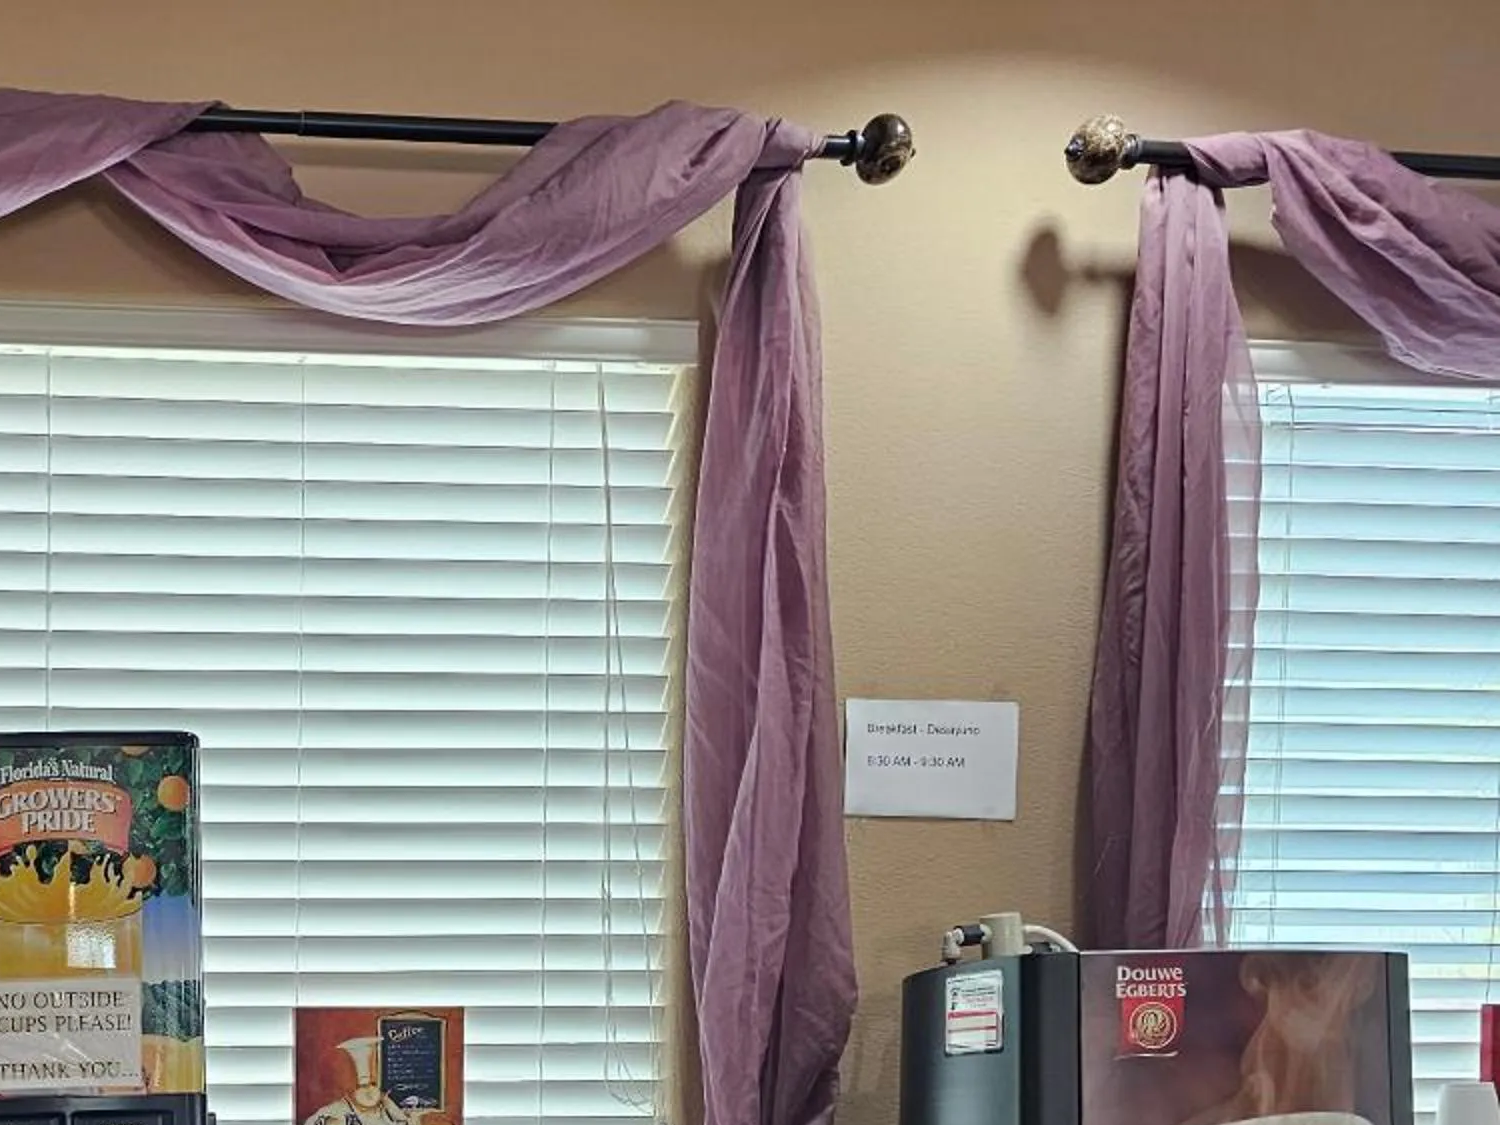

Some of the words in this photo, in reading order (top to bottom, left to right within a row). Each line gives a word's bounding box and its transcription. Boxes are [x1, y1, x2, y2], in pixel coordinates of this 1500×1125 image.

[867, 723, 917, 735] Breakfast
[0, 757, 59, 785] Florida's
[61, 759, 114, 781] Natural
[892, 755, 911, 767] AM
[946, 757, 966, 768] AM
[21, 809, 97, 834] PRIDE
[33, 990, 125, 1010] OUTSIDE
[1115, 982, 1187, 998] EGBERTS
[55, 1013, 132, 1034] PLEASE!
